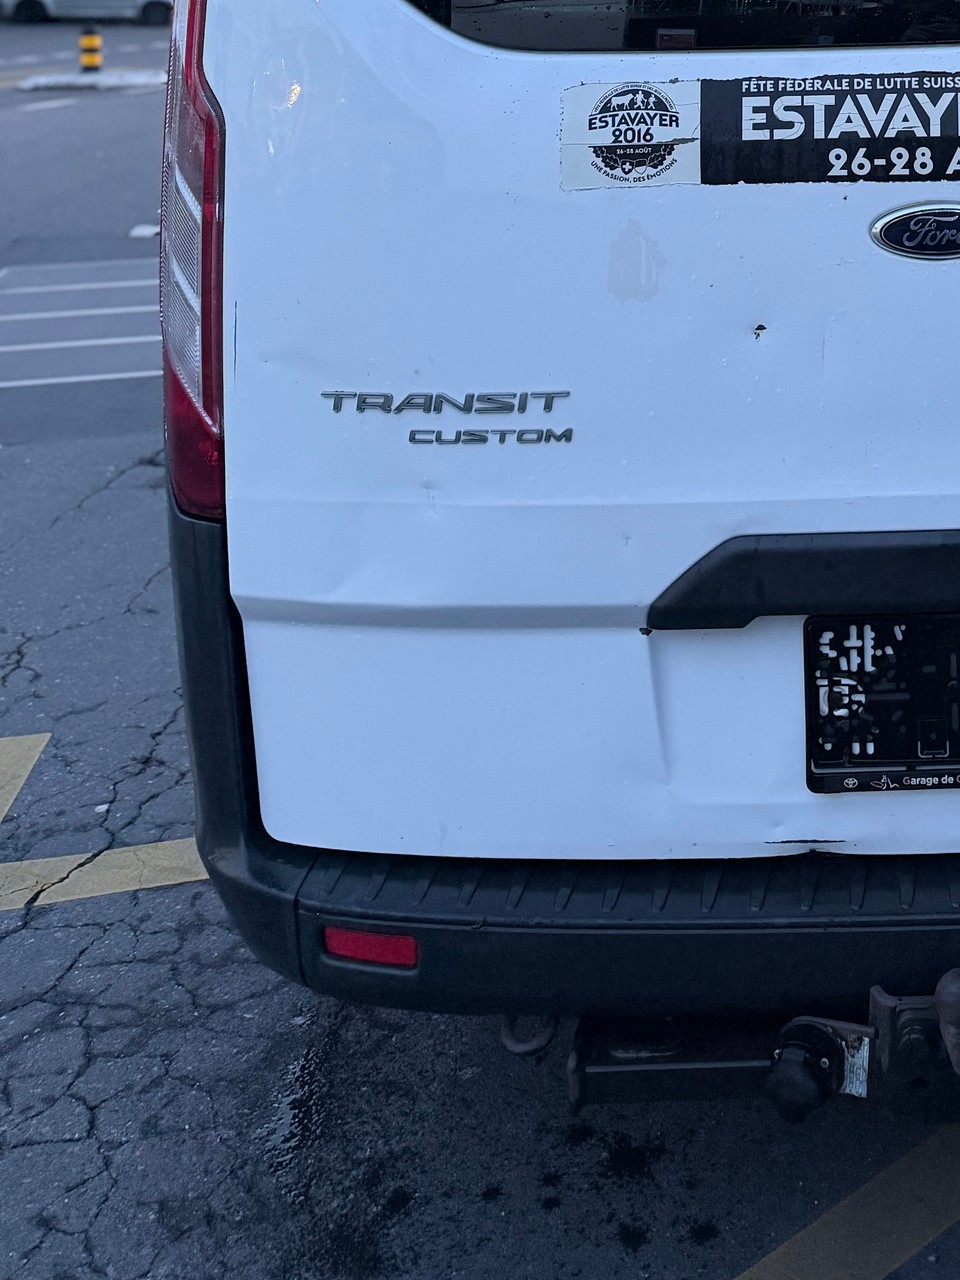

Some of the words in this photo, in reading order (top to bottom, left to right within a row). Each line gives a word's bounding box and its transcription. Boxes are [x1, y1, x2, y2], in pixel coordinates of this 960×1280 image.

[742, 78, 774, 93] FÊTE
[778, 78, 850, 92] FÉDÉRALE
[853, 78, 873, 90] DE
[876, 77, 919, 89] LUTTE
[588, 112, 680, 130] ESTAVAYER
[611, 127, 654, 144] 2016
[590, 160, 604, 173] UNE
[602, 170, 632, 183] PASSION,
[647, 158, 678, 179] ÉMOTIONS
[827, 147, 934, 177] 26-28
[320, 390, 571, 414] TRANSIT
[408, 428, 574, 445] CUSTOM
[902, 776, 939, 786] Garage
[940, 774, 954, 784] de
